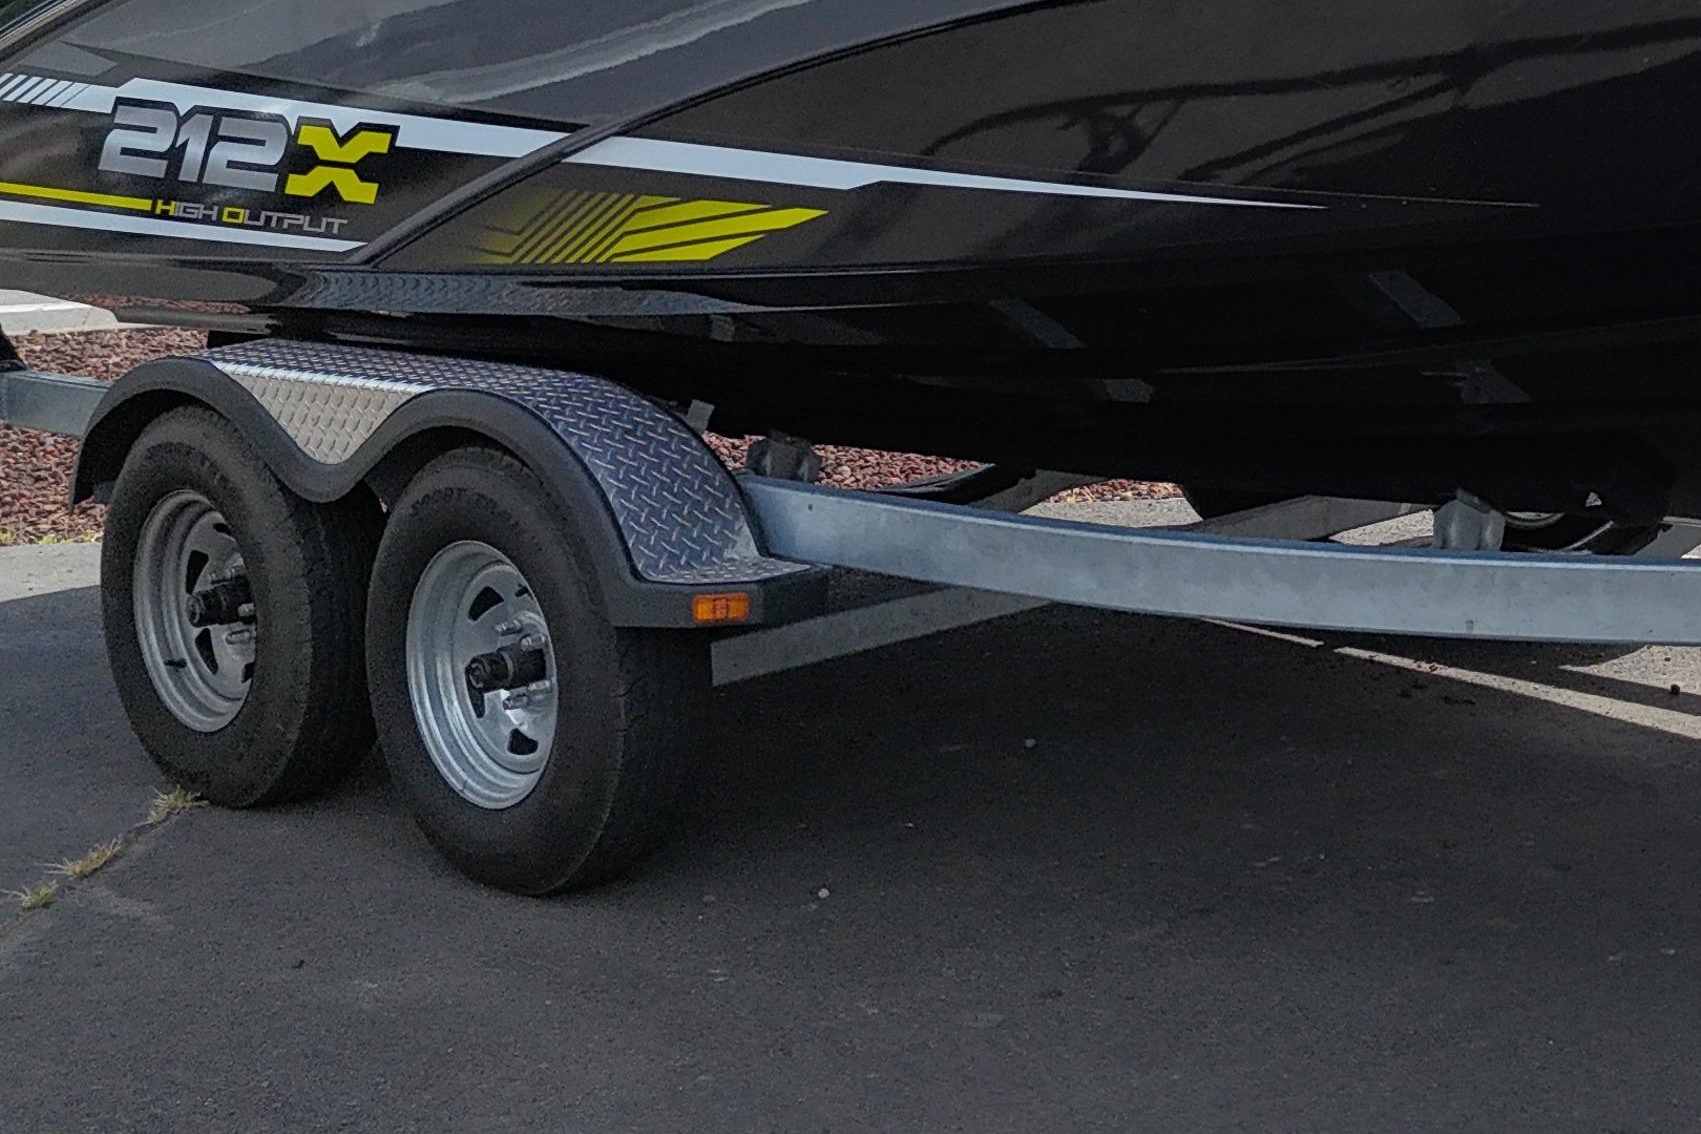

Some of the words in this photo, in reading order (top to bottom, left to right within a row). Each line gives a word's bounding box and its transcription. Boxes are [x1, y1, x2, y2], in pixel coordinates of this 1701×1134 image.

[98, 104, 393, 205] 212X
[155, 198, 218, 220] HIGH
[221, 207, 348, 235] OUTPUT
